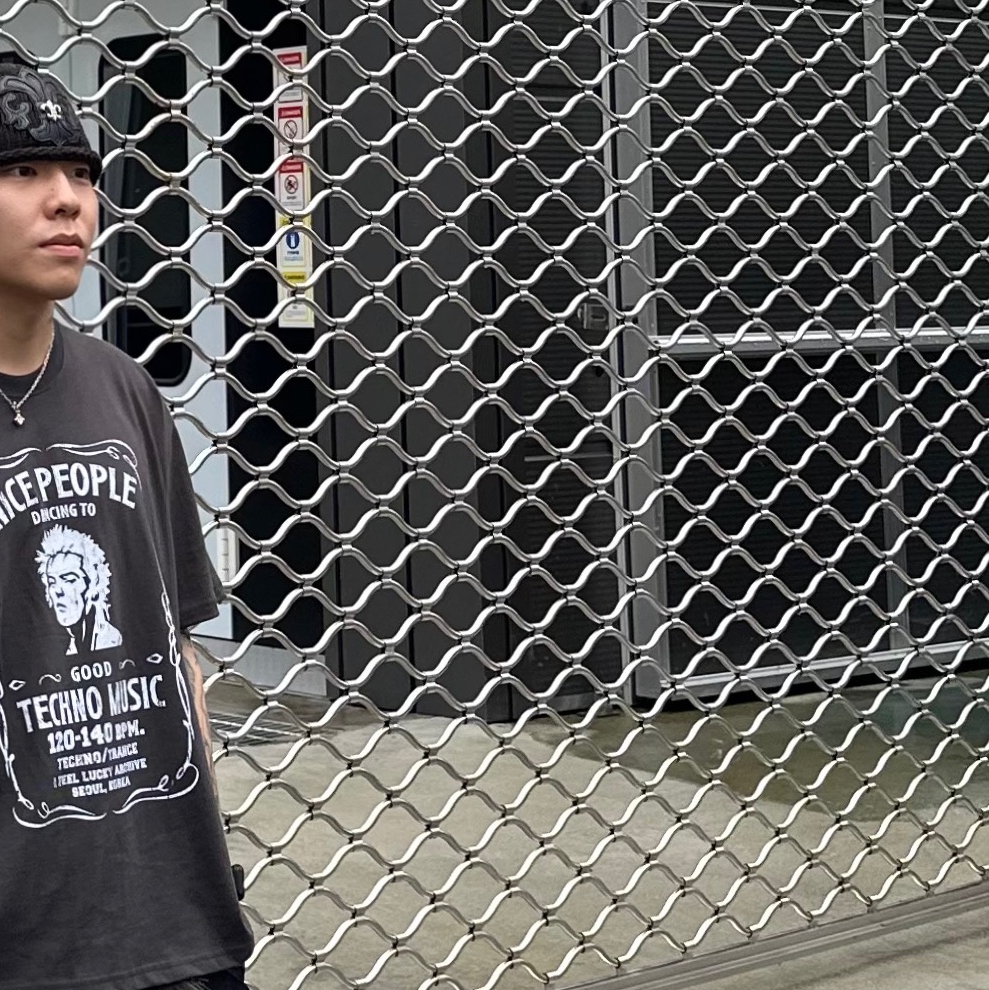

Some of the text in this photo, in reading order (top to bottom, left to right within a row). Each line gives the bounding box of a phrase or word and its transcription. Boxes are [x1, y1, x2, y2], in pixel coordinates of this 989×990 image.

[34, 462, 137, 508] PEOPLE
[78, 502, 97, 517] TO
[70, 661, 112, 682] GOOD
[16, 674, 166, 733] TECHNO MUSIC
[47, 722, 114, 754] 120-140
